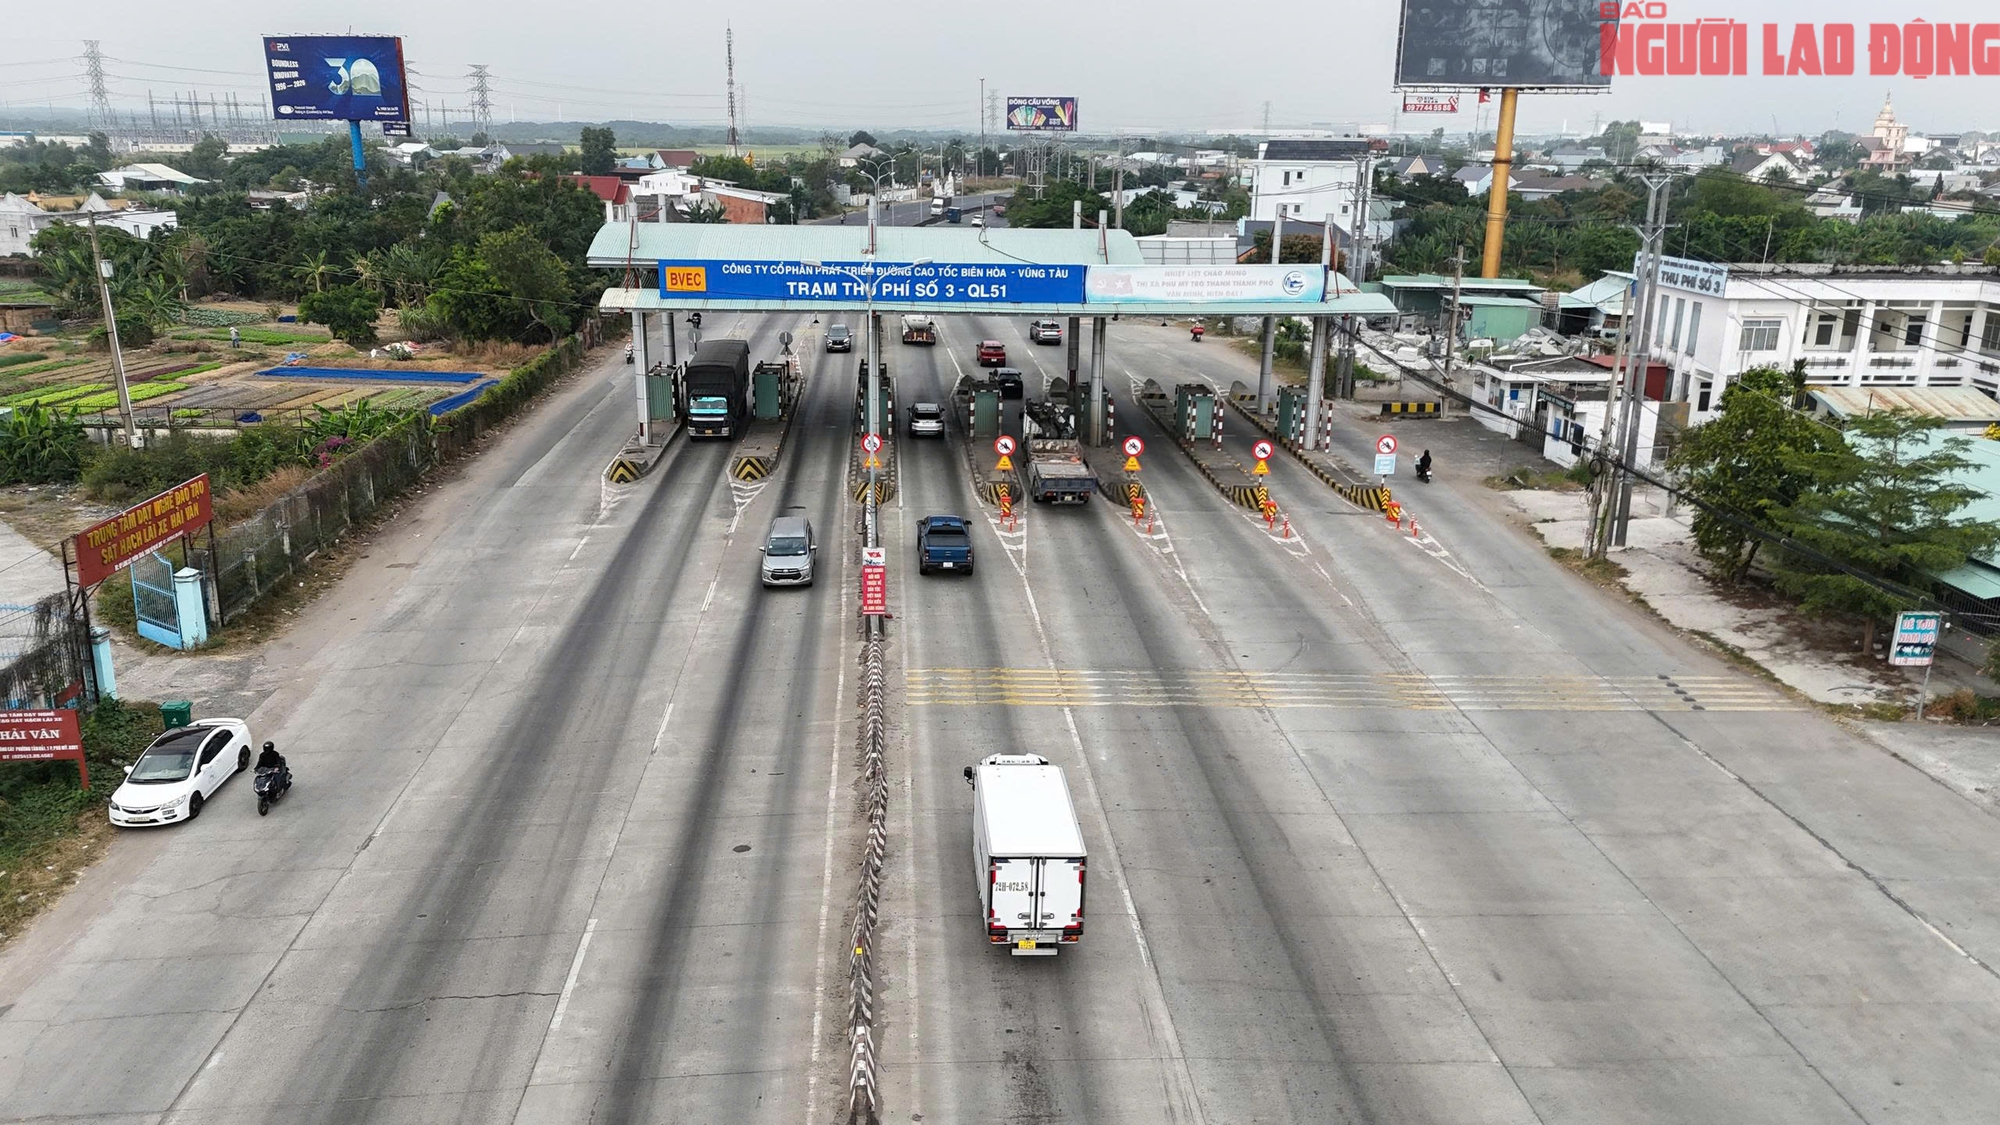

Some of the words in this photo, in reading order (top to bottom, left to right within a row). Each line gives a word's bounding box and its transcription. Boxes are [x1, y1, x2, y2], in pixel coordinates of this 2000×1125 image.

[670, 272, 701, 287] BVEC
[722, 262, 752, 274] CÔNG
[754, 265, 768, 274] TY
[914, 267, 935, 277] CAO
[938, 265, 958, 277] TỐC
[961, 266, 984, 277] BIÊN
[986, 266, 1006, 278] HÒA
[1018, 266, 1045, 278] VŨNG
[1048, 266, 1069, 279] TÀU
[787, 281, 837, 298] TRẠM
[882, 280, 911, 297] PHÍ
[915, 279, 939, 297] SỐ
[945, 284, 955, 298] 3
[967, 284, 1007, 298] QL51
[1661, 271, 1679, 286] THU
[1680, 274, 1698, 289] PHÍ
[1698, 274, 1712, 292] SỐ
[1713, 281, 1720, 294] 3
[87, 522, 118, 549] TRUNG
[118, 512, 137, 534] TÂM
[190, 480, 204, 500] TẠO
[101, 542, 119, 564] SÁT
[120, 534, 143, 555] HẠCH
[158, 518, 169, 536] XE
[171, 507, 185, 529] HẢI
[185, 501, 200, 520] VÂN
[29, 728, 60, 739] VÂN
